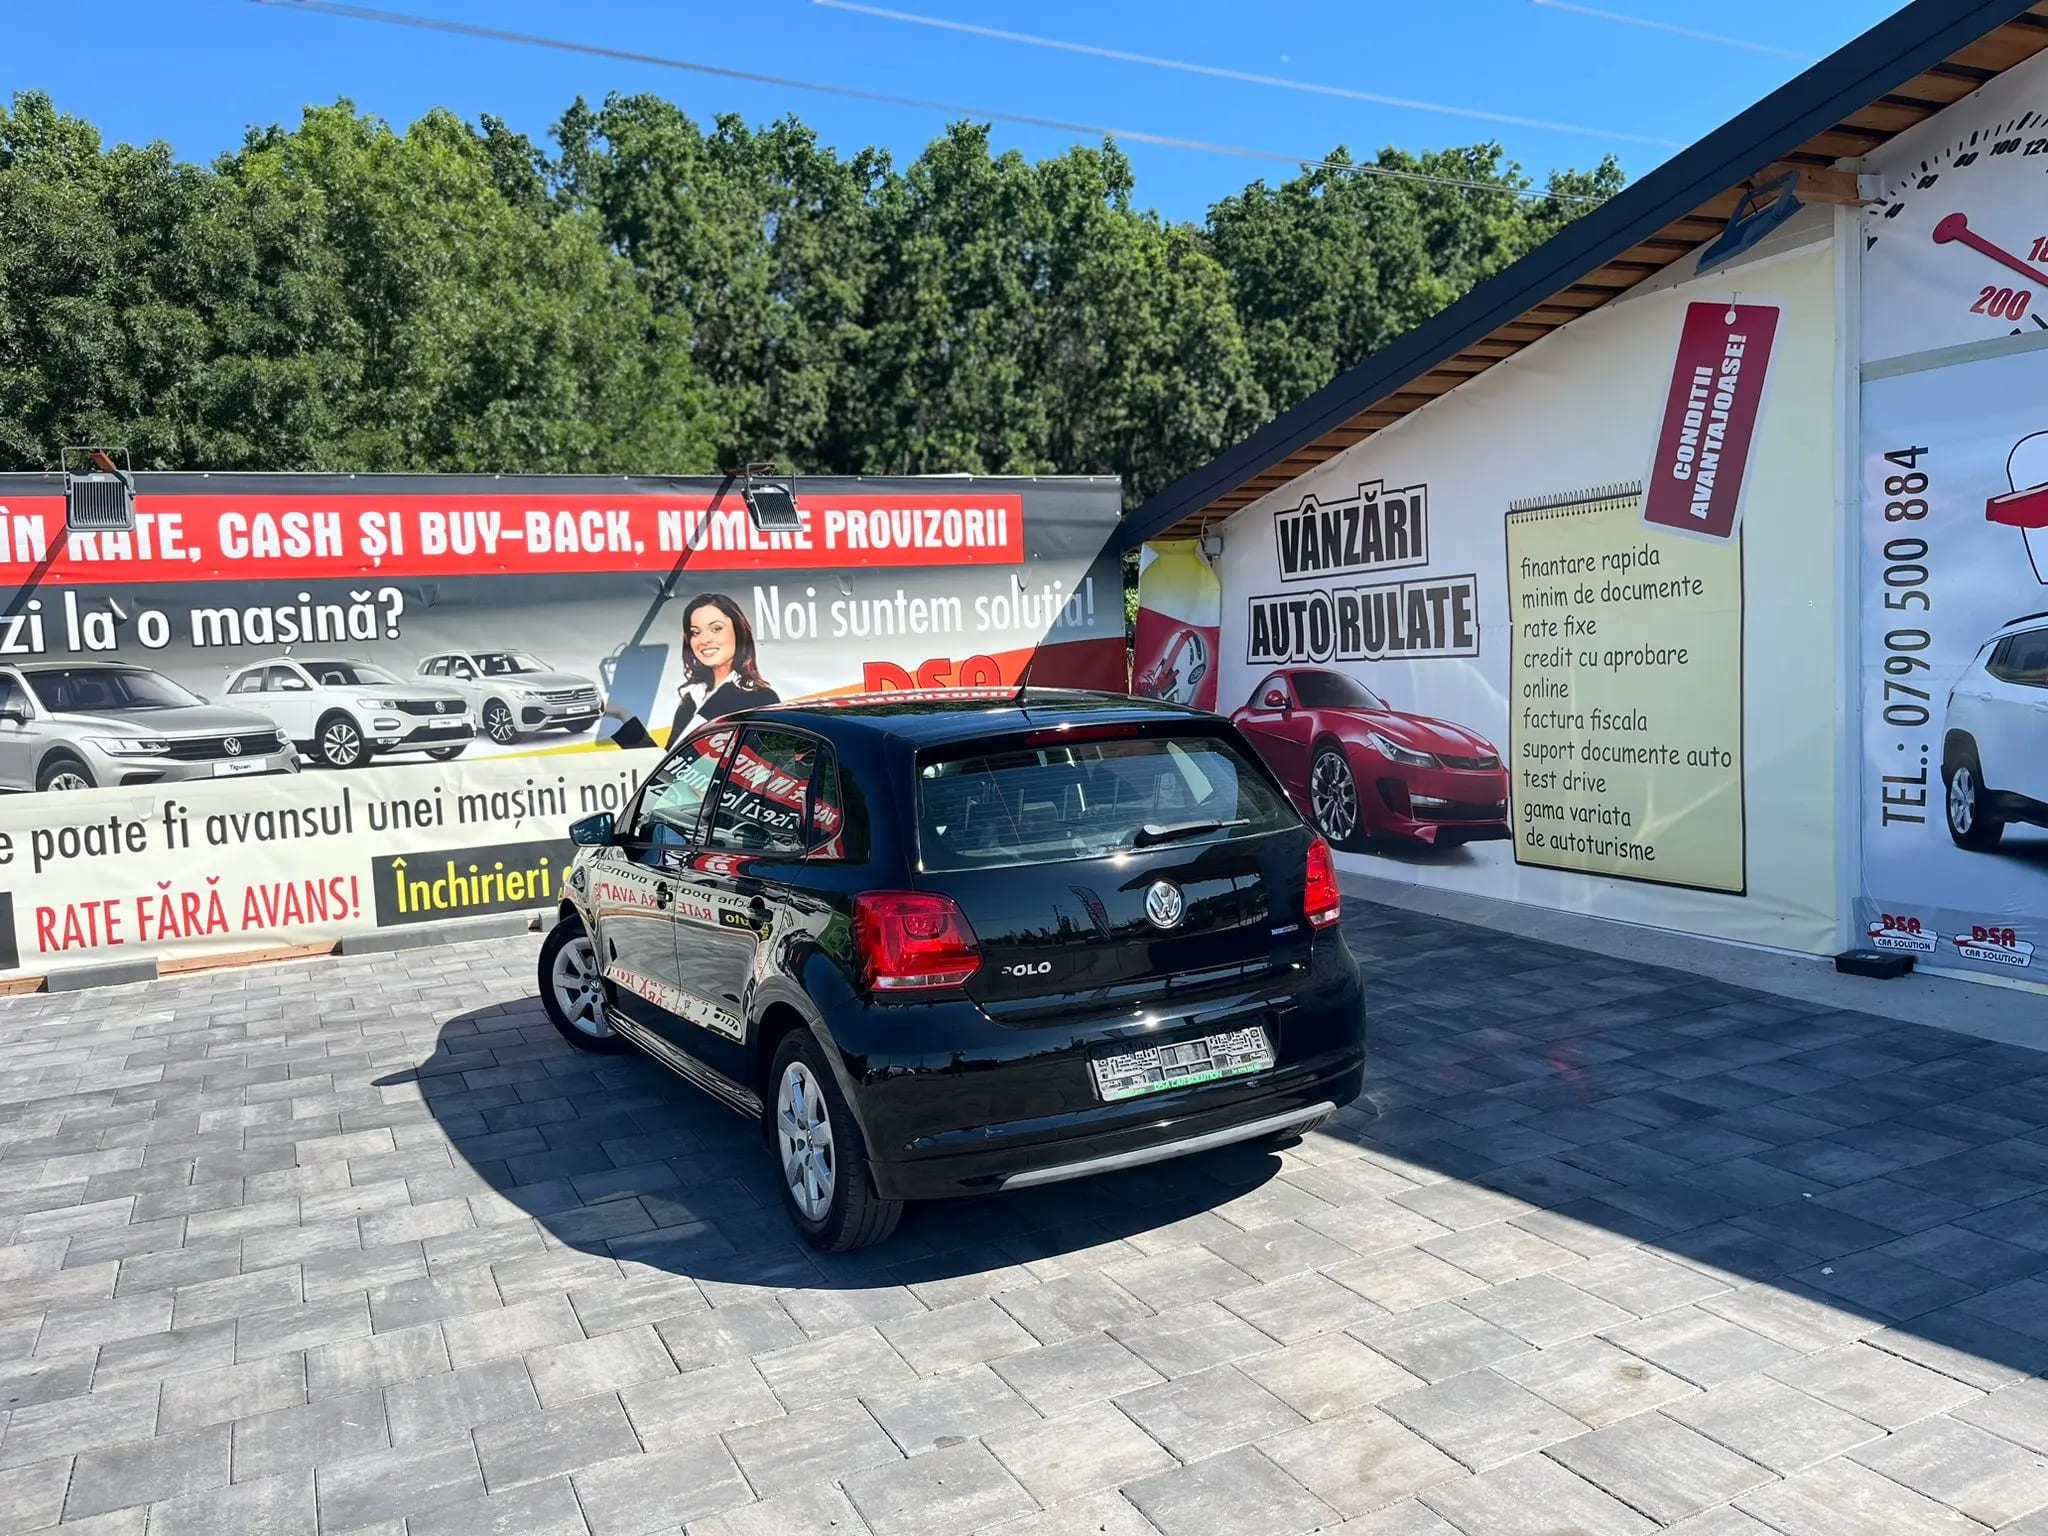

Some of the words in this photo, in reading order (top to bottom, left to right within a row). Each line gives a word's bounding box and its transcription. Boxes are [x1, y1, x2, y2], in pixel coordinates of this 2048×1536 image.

[1953, 152, 1979, 168] 80
[1990, 138, 2022, 156] 100
[1917, 174, 1939, 189] 60
[1970, 286, 2031, 320] 200
[1673, 366, 1714, 481] CONDITII
[1690, 333, 1747, 520] AVANTAJOASE!
[1884, 445, 1929, 522] 884
[218, 512, 343, 558] CASH
[359, 511, 403, 567] ȘI
[419, 509, 645, 556] BUY-BACK,
[825, 508, 1008, 549] PROVIZORII
[1280, 490, 1422, 573] VÂNZĂRI
[1520, 555, 1596, 579] finantare
[1602, 543, 1660, 575] rapida
[1883, 538, 1930, 611] 500
[753, 585, 817, 640] Noi
[832, 589, 963, 637] suntem
[975, 574, 1094, 631] solutia!
[1522, 586, 1568, 609] minim
[1573, 582, 1595, 604] de
[1600, 575, 1704, 602] documente
[63, 590, 118, 652] la
[137, 609, 171, 648] o
[190, 586, 404, 655] mașină?
[1251, 598, 1330, 656] AUTO
[1338, 584, 1473, 653] RULATE
[1523, 618, 1558, 638] rate
[1564, 614, 1597, 638] fixe
[1523, 645, 1573, 668] credit
[1579, 649, 1598, 667] cu
[1603, 642, 1689, 673] aprobare
[1523, 676, 1569, 698] online
[1883, 629, 1931, 726] 0790
[1523, 707, 1584, 729] factura
[1590, 708, 1648, 731] fiscala
[1522, 741, 1575, 764] suport
[1581, 739, 1680, 765] documente
[1687, 746, 1732, 768] auto
[1523, 769, 1557, 790] test
[1563, 770, 1607, 793] drive
[1882, 743, 1928, 827] TEL.:
[31, 816, 148, 874] poate
[162, 800, 190, 849] fi
[206, 787, 353, 846] avansul
[368, 786, 443, 831] unei
[458, 776, 568, 829] mașini
[1524, 803, 1564, 823] gama
[1569, 804, 1631, 827] variata
[1526, 826, 1545, 847] de
[1550, 832, 1655, 861] autoturisme
[392, 856, 550, 913] Închirieri
[35, 899, 125, 953] RATE
[136, 875, 229, 942] FĂRĂ
[241, 875, 360, 931] AVANS!
[1881, 914, 1922, 934] DSA
[1878, 938, 1891, 946] CAR
[1894, 940, 1931, 950] SOLUTION
[1972, 926, 2016, 947] DSA
[1965, 948, 1981, 957] CAR
[1983, 952, 2024, 964] SOLUTION
